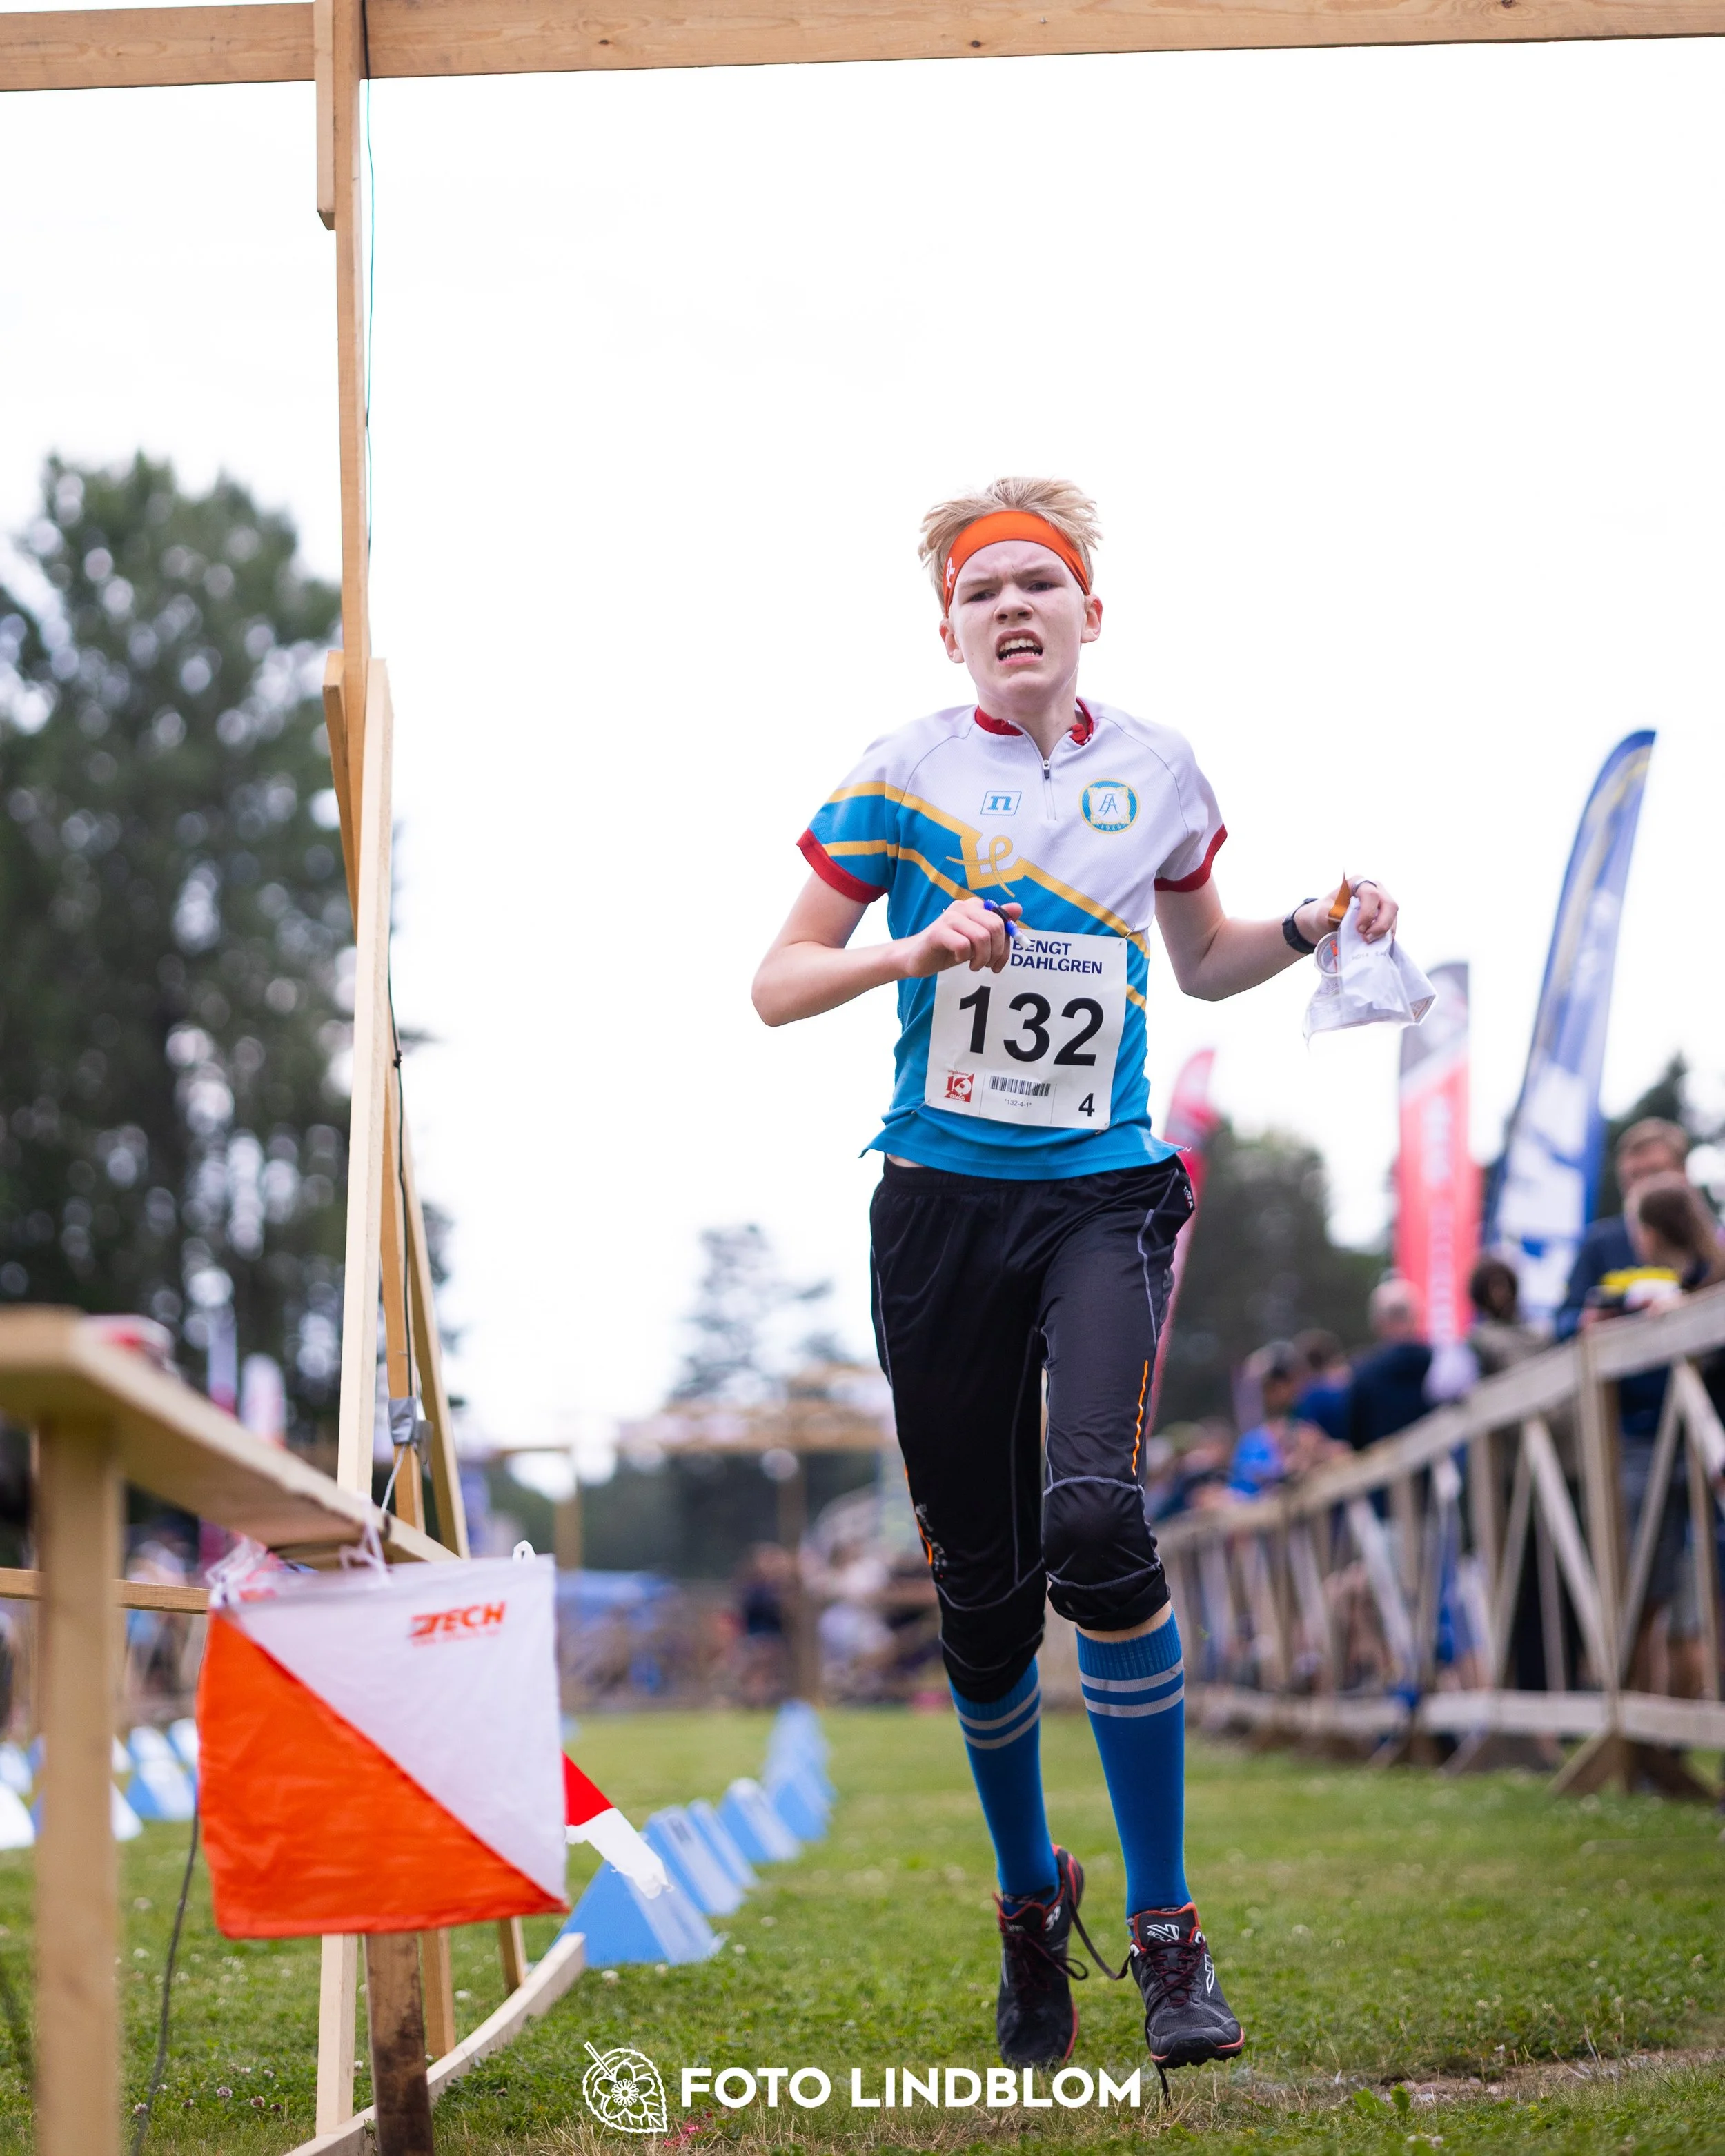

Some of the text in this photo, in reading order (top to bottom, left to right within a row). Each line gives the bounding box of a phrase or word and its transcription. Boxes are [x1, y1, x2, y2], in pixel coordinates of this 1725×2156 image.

[1012, 938, 1072, 956] BENGT
[1010, 953, 1103, 974] DAHLGREN
[958, 985, 1104, 1067] 132
[1078, 1092, 1095, 1117] 4
